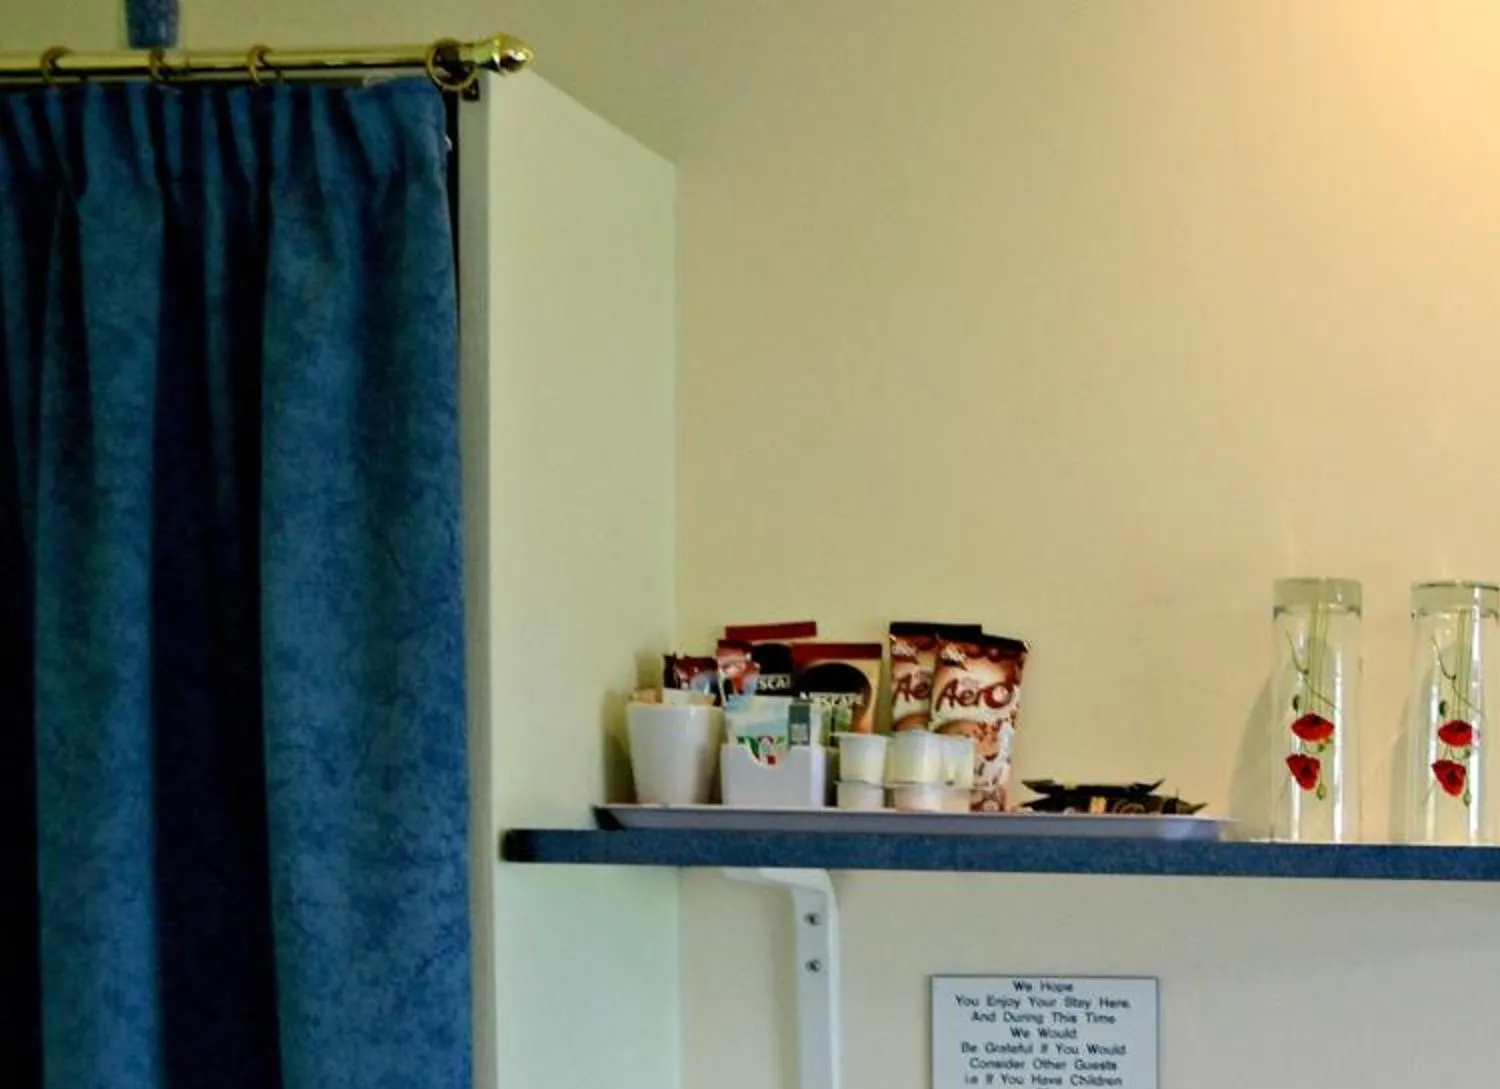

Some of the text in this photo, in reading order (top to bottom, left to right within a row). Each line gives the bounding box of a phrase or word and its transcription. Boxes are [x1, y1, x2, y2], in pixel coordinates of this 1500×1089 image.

[892, 673, 930, 706] Ae
[1012, 980, 1074, 993] We Hope
[955, 995, 979, 1007] You
[986, 995, 1021, 1009] Enjoy
[1028, 995, 1056, 1008] Your
[1064, 996, 1091, 1009] Stay
[970, 1012, 1116, 1025] And During This Time
[1009, 1026, 1077, 1038] We Would
[961, 1042, 1127, 1055] Be Grateful If You Would
[969, 1057, 1117, 1071] Consider Other Guests
[986, 1074, 994, 1085] If
[1000, 1074, 1024, 1085] You
[1031, 1074, 1063, 1086] Have
[1070, 1074, 1122, 1086] Children
